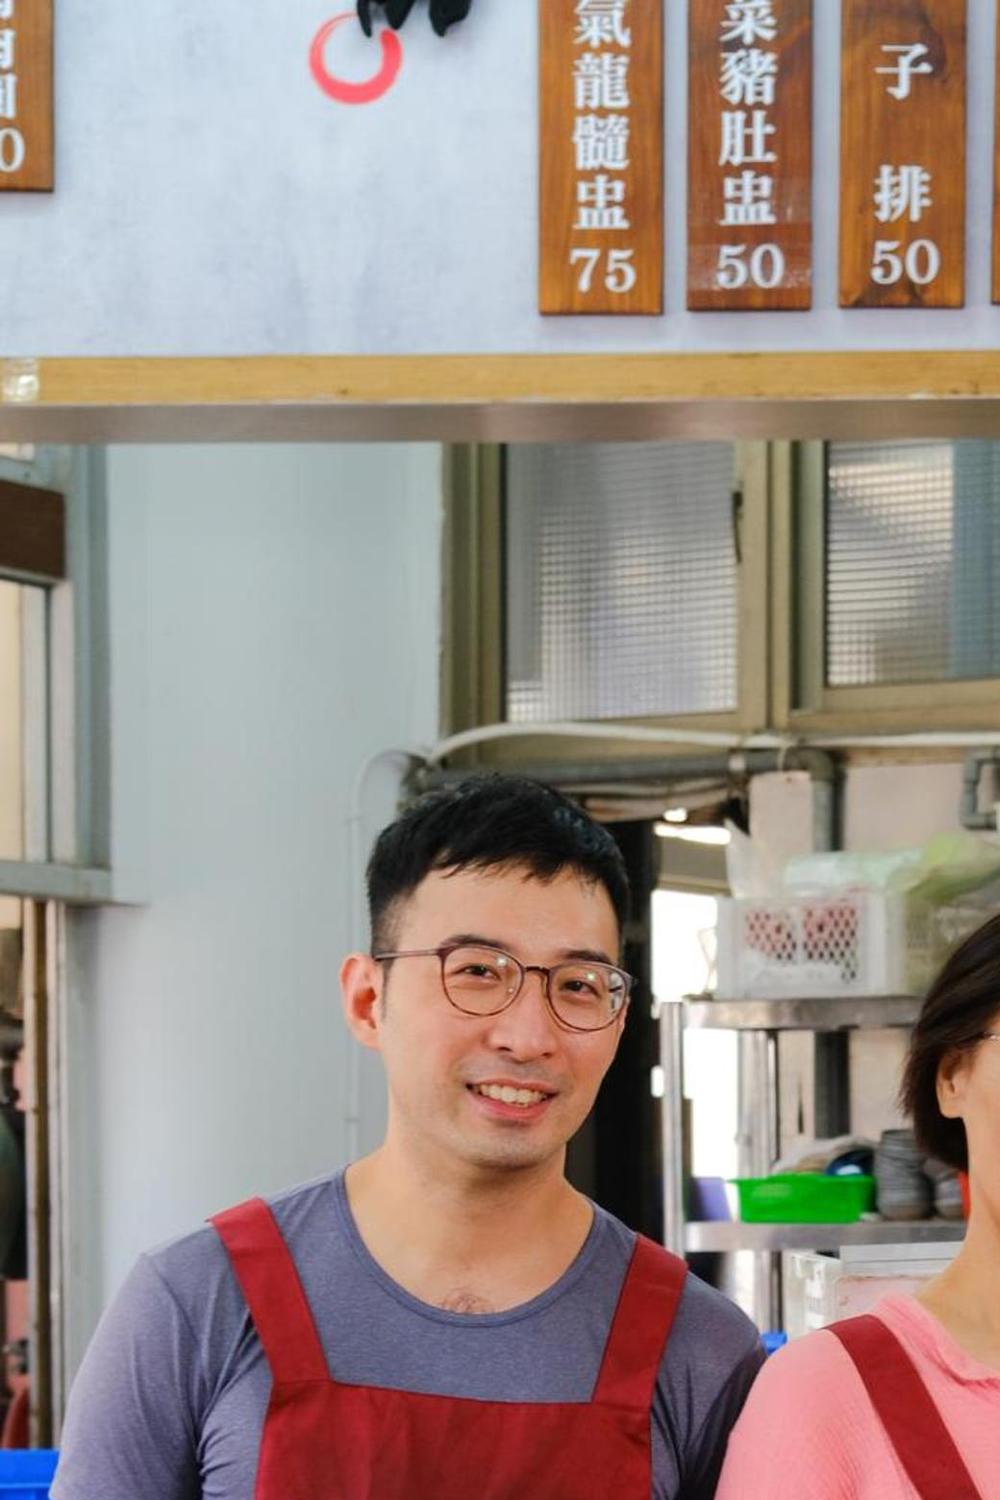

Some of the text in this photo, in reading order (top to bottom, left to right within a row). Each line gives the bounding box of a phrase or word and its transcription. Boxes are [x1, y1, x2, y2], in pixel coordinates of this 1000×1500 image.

[569, 248, 637, 293] 75
[716, 243, 785, 290] 50
[870, 239, 940, 285] 50
